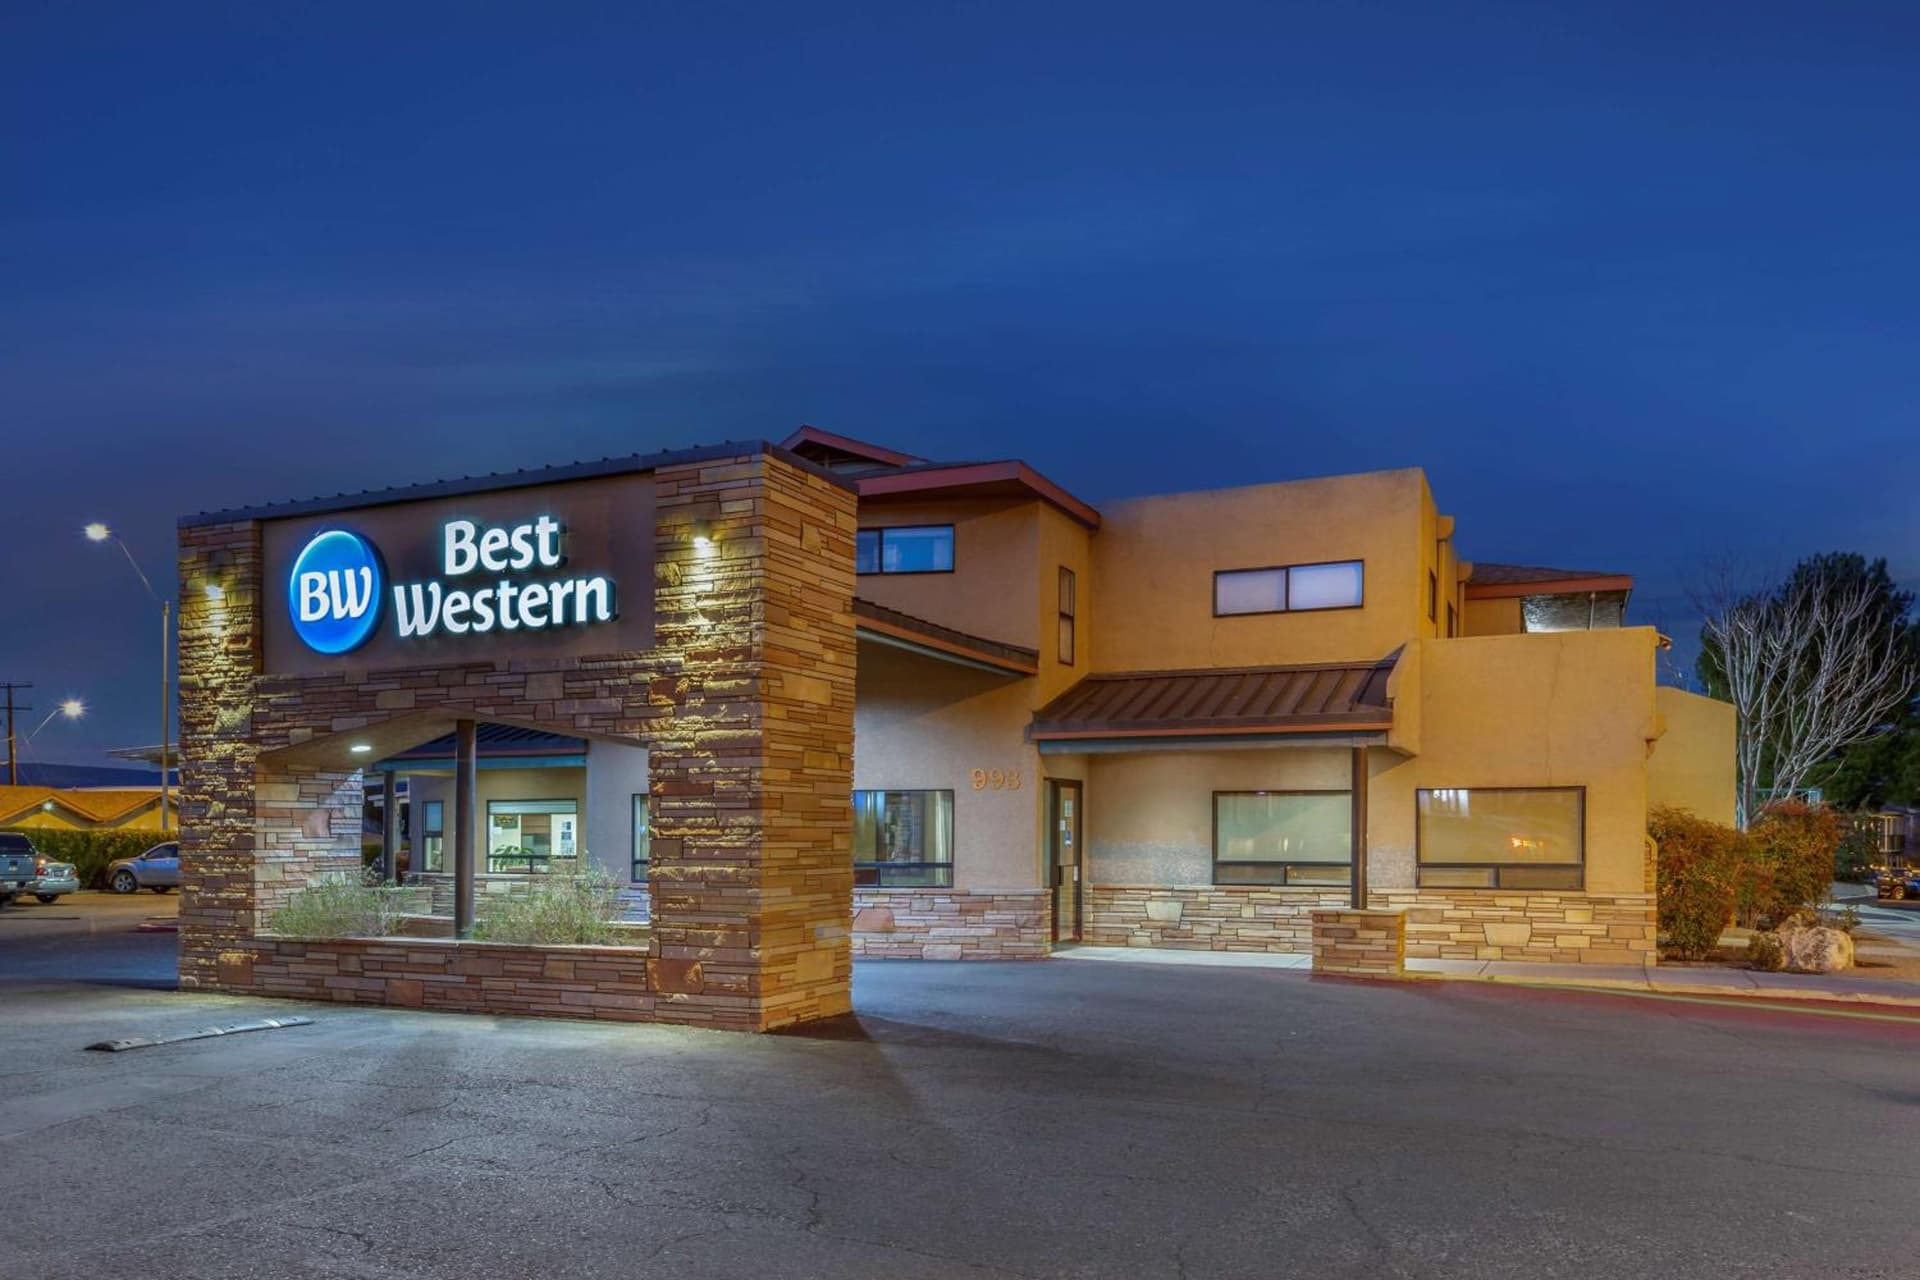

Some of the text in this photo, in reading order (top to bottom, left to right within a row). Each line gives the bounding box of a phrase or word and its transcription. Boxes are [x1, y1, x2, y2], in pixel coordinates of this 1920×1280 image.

[444, 515, 560, 575] Best
[299, 566, 372, 622] BW
[393, 576, 611, 637] Western
